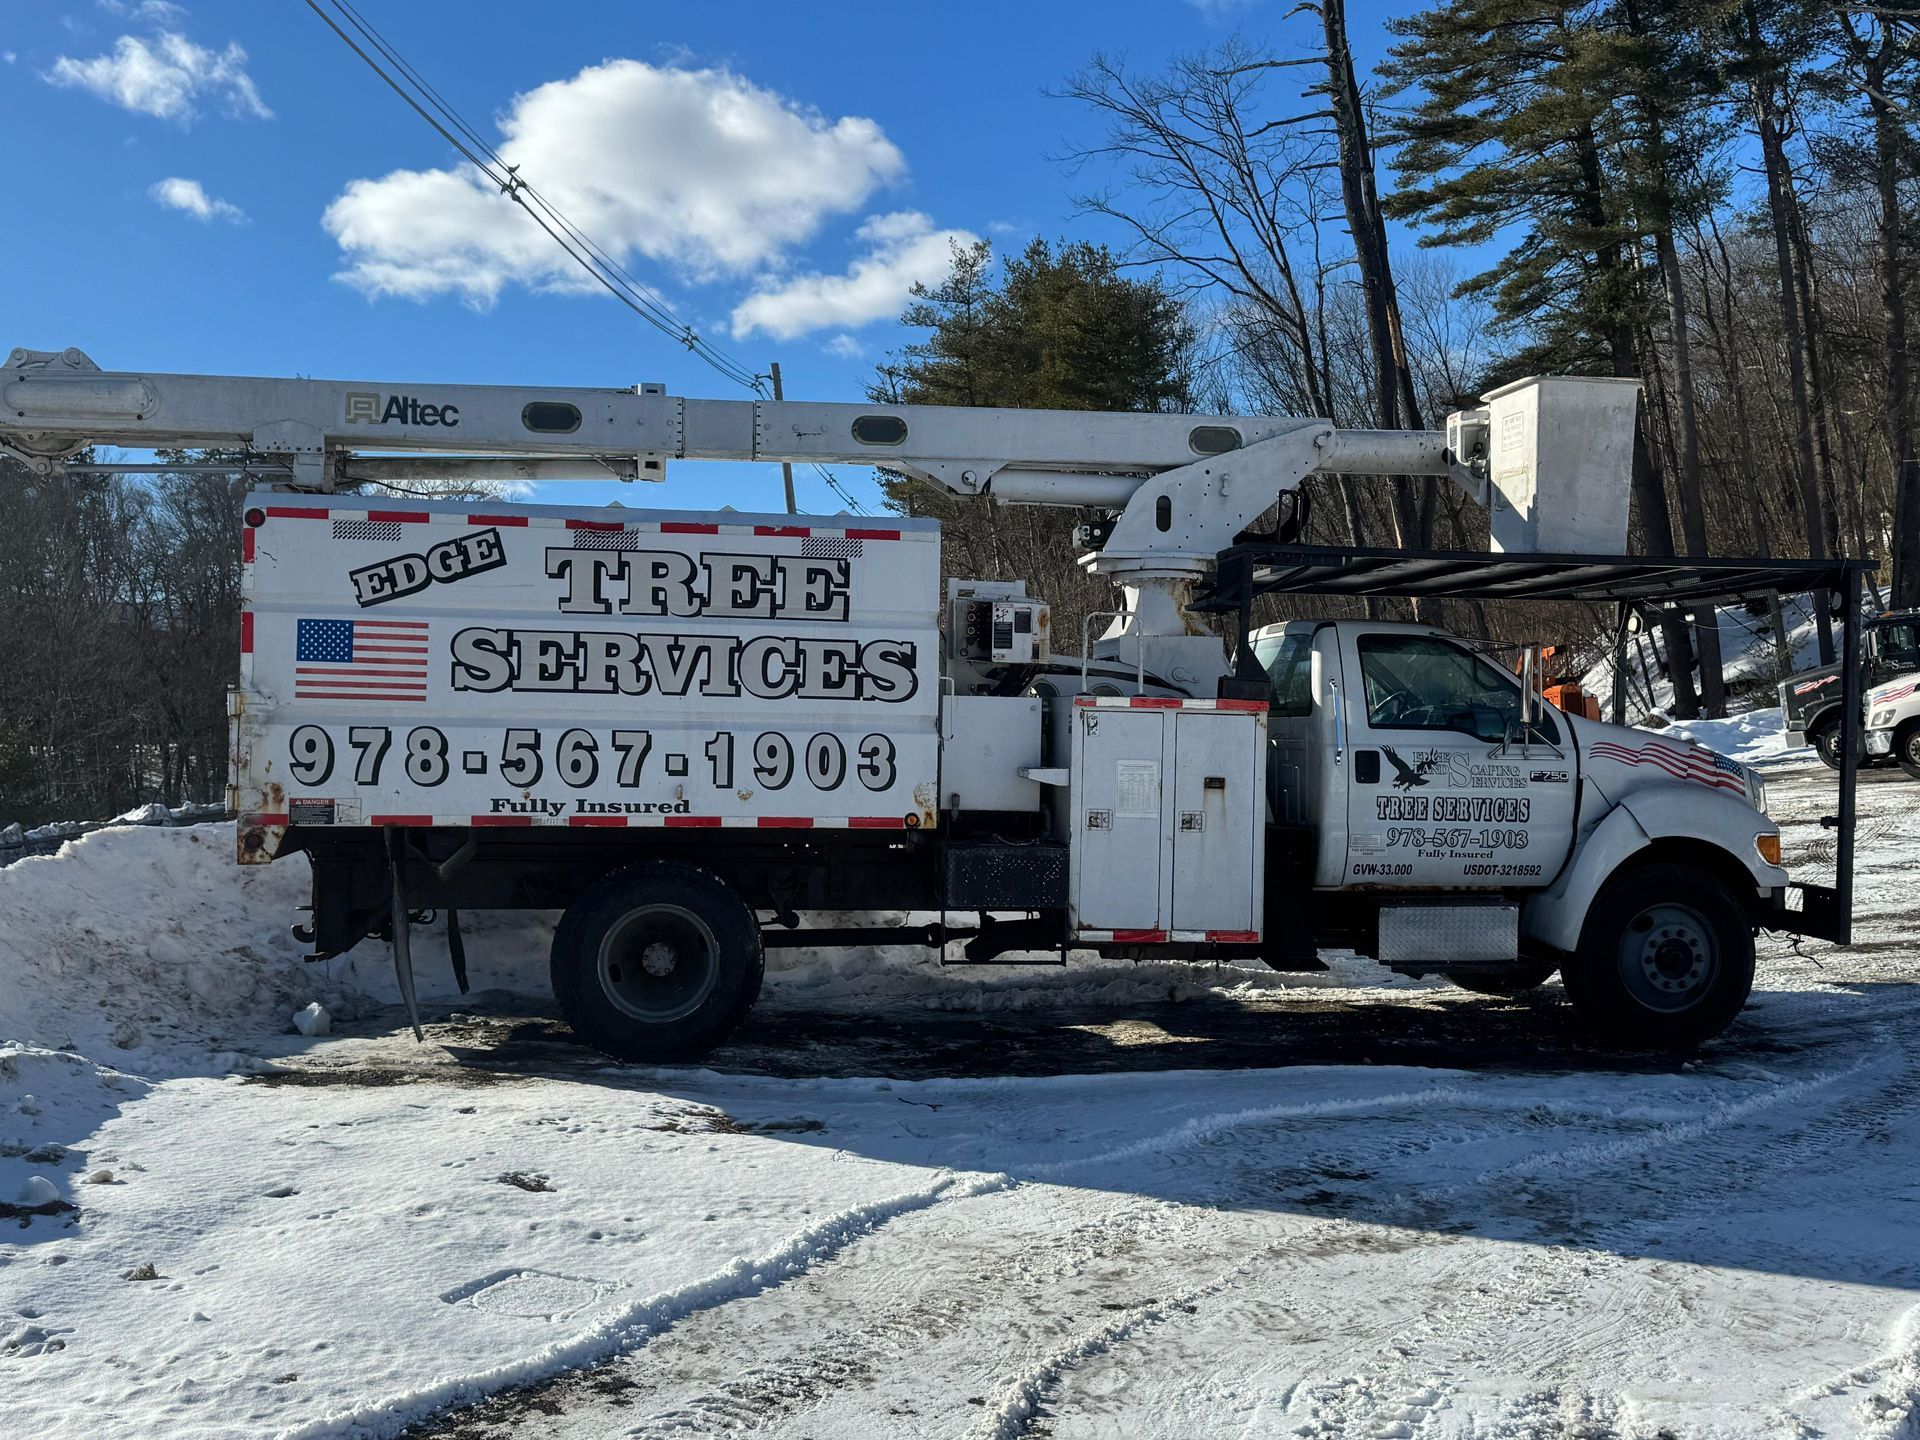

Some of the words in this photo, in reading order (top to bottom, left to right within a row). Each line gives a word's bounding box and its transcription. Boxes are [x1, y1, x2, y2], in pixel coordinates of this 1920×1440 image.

[381, 395, 460, 427] Altec
[349, 528, 507, 607] EDGE
[545, 546, 850, 622] TREE
[451, 626, 918, 702] SERVICES
[289, 723, 896, 792] 978-567-1903
[490, 798, 566, 817] Fully
[575, 799, 691, 814] Insured
[1377, 796, 1428, 821] TREE
[1433, 797, 1530, 823] SERVICES
[1387, 827, 1529, 849] 978-567-1903
[1417, 849, 1447, 860] Fully
[1450, 850, 1494, 859] Insured
[1463, 864, 1542, 876] USDOT-3218592
